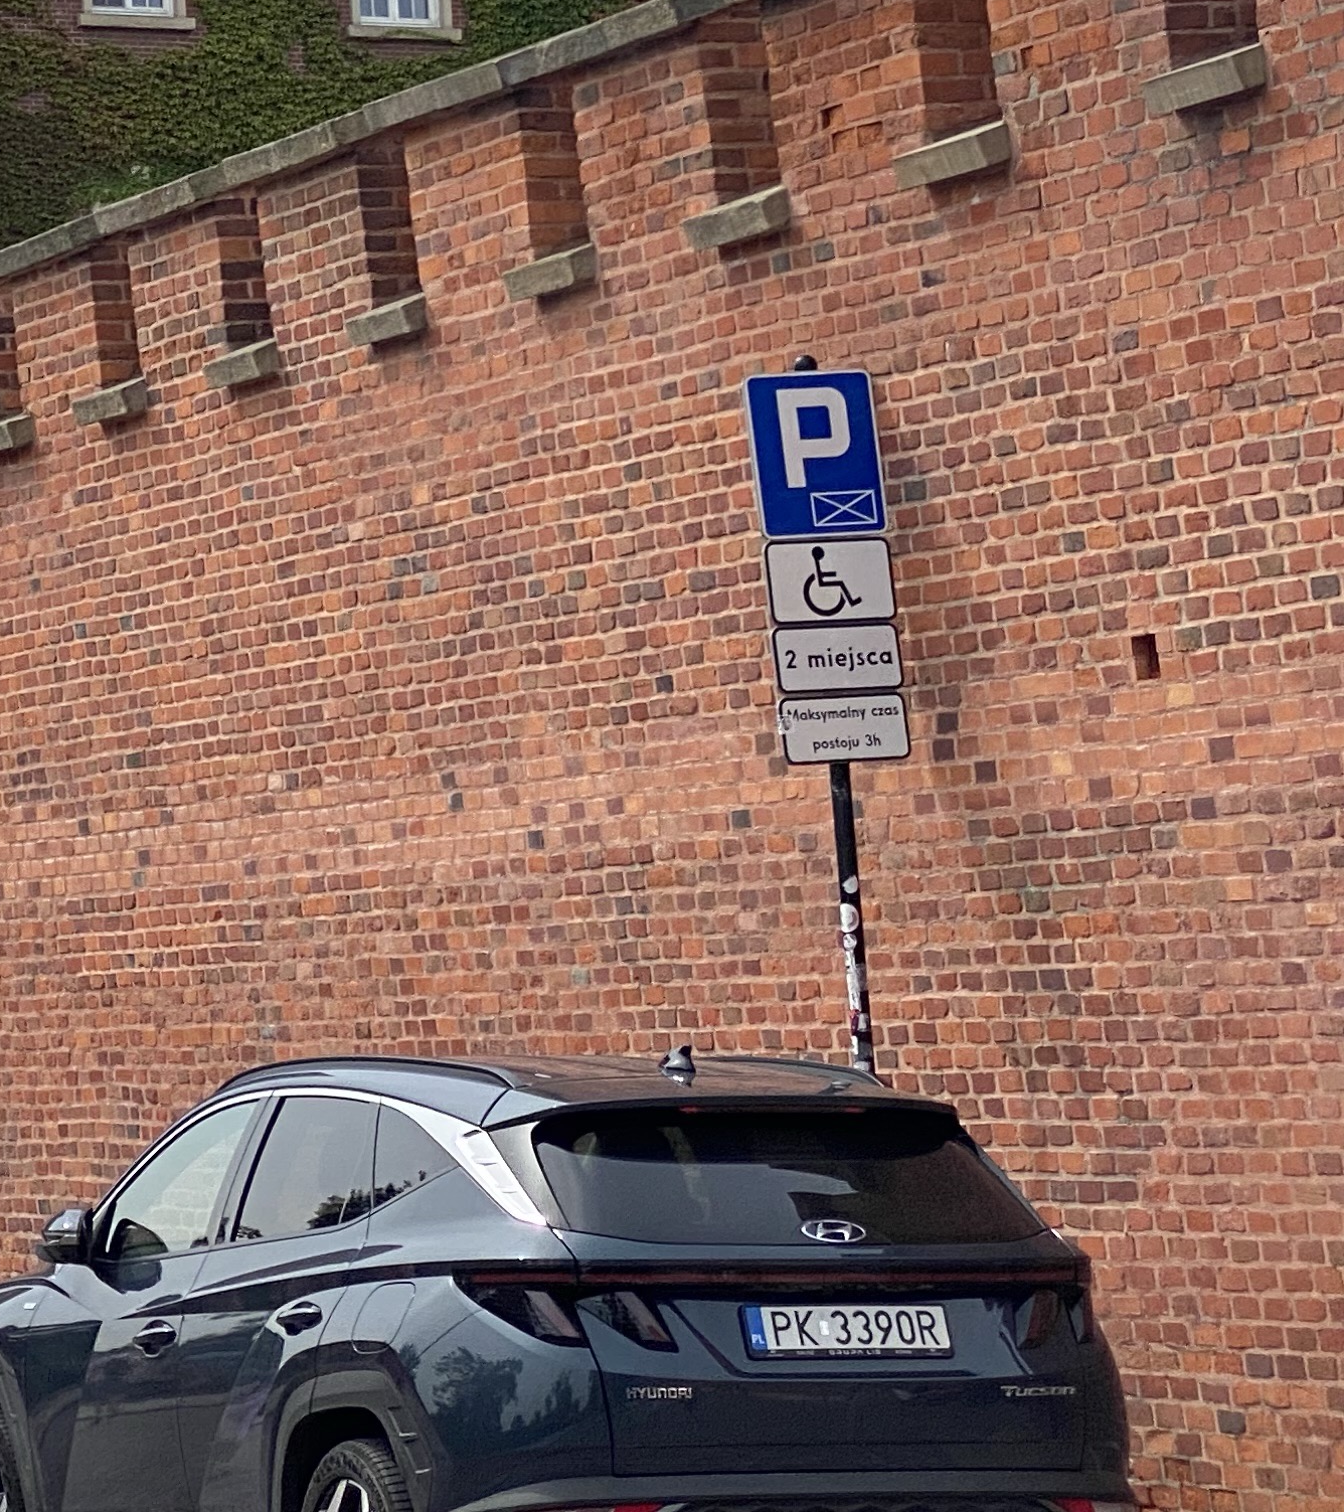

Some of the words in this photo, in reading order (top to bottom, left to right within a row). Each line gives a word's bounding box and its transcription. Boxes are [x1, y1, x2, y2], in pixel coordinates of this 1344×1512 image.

[776, 386, 852, 489] P
[785, 649, 797, 669] 2
[807, 646, 893, 671] miejsca
[787, 706, 866, 723] Maksymalny
[871, 705, 899, 717] czas
[813, 735, 860, 754] postoju
[864, 733, 882, 747] 3h
[771, 1310, 820, 1346] PK
[831, 1310, 941, 1346] 3390R
[751, 1334, 765, 1344] PL
[626, 1386, 692, 1399] HYUNDAI
